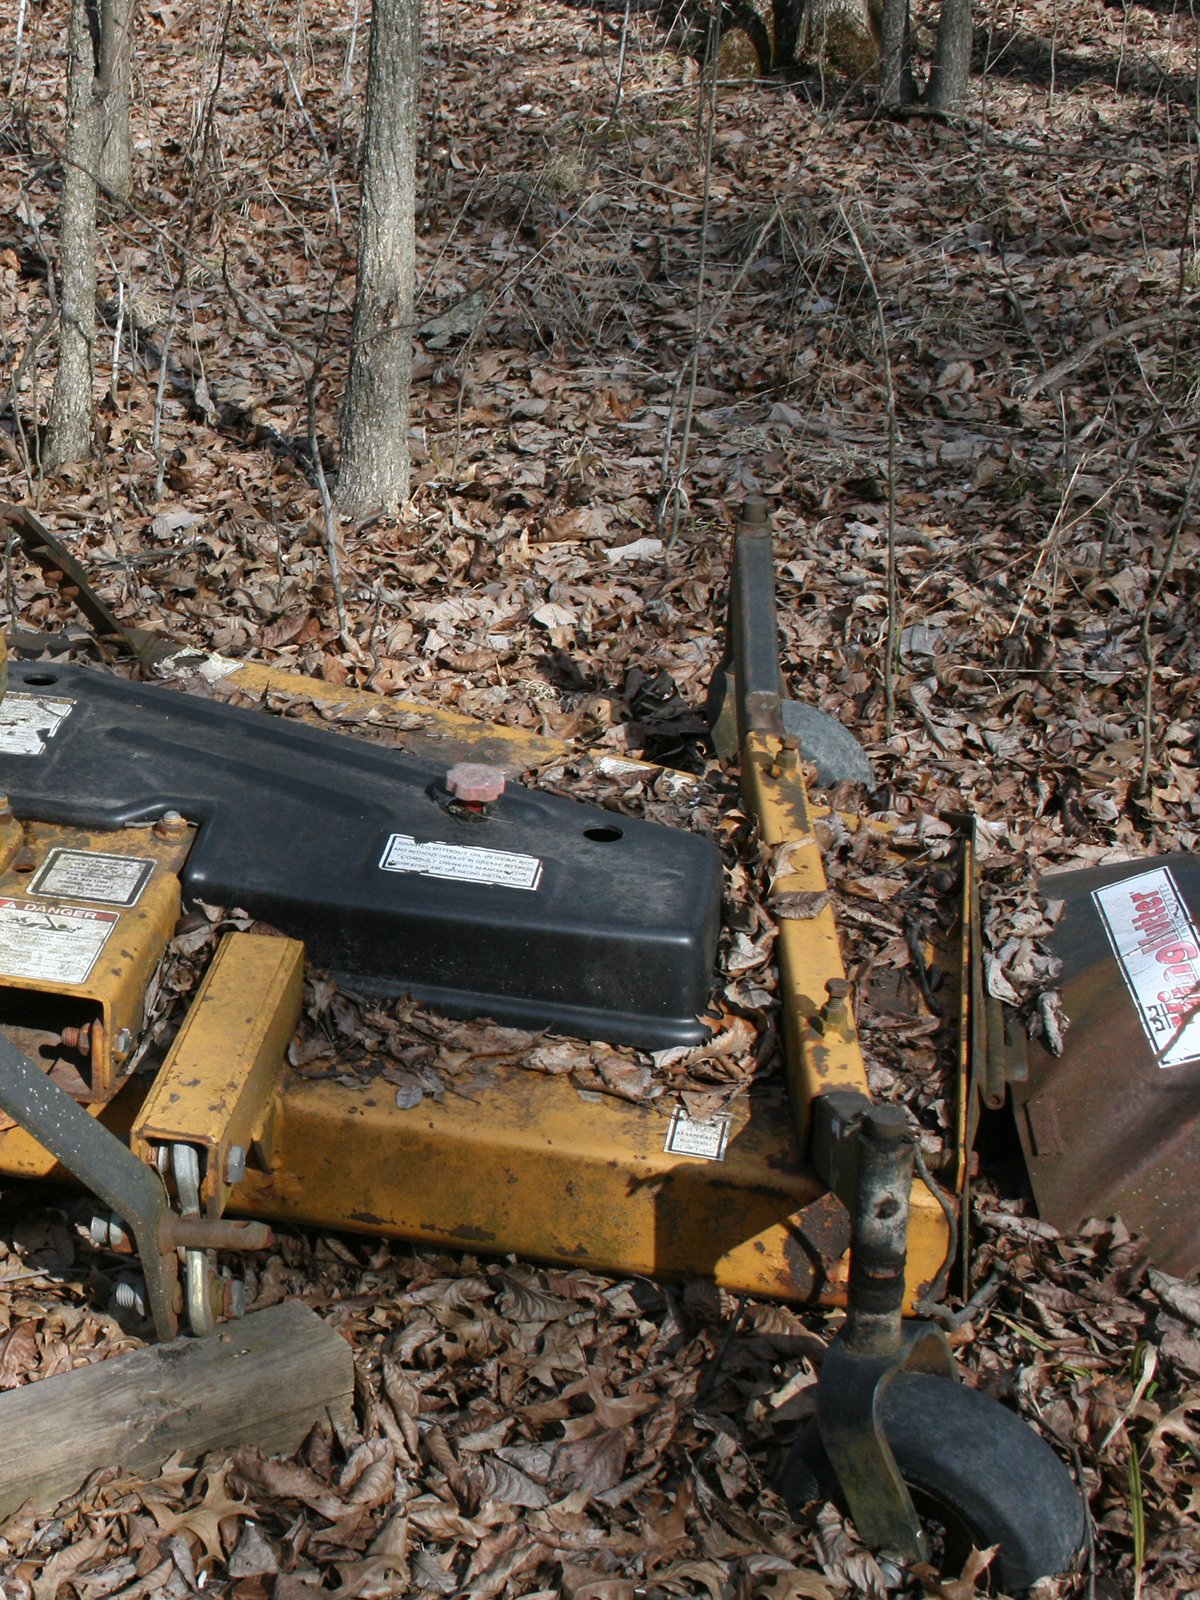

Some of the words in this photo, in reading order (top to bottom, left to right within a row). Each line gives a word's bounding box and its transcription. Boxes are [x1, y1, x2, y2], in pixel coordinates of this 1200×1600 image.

[408, 849, 439, 858] WITHOUT
[439, 853, 468, 862] GREASE
[475, 858, 503, 867] GREASE
[432, 845, 468, 856] WITHOUT
[494, 855, 518, 864] GEAR
[400, 855, 437, 864] CONSULT
[475, 865, 510, 875] MANUA
[23, 903, 97, 920] DANGER
[1160, 882, 1190, 938] INCOORATED
[1130, 890, 1178, 956] Kutter
